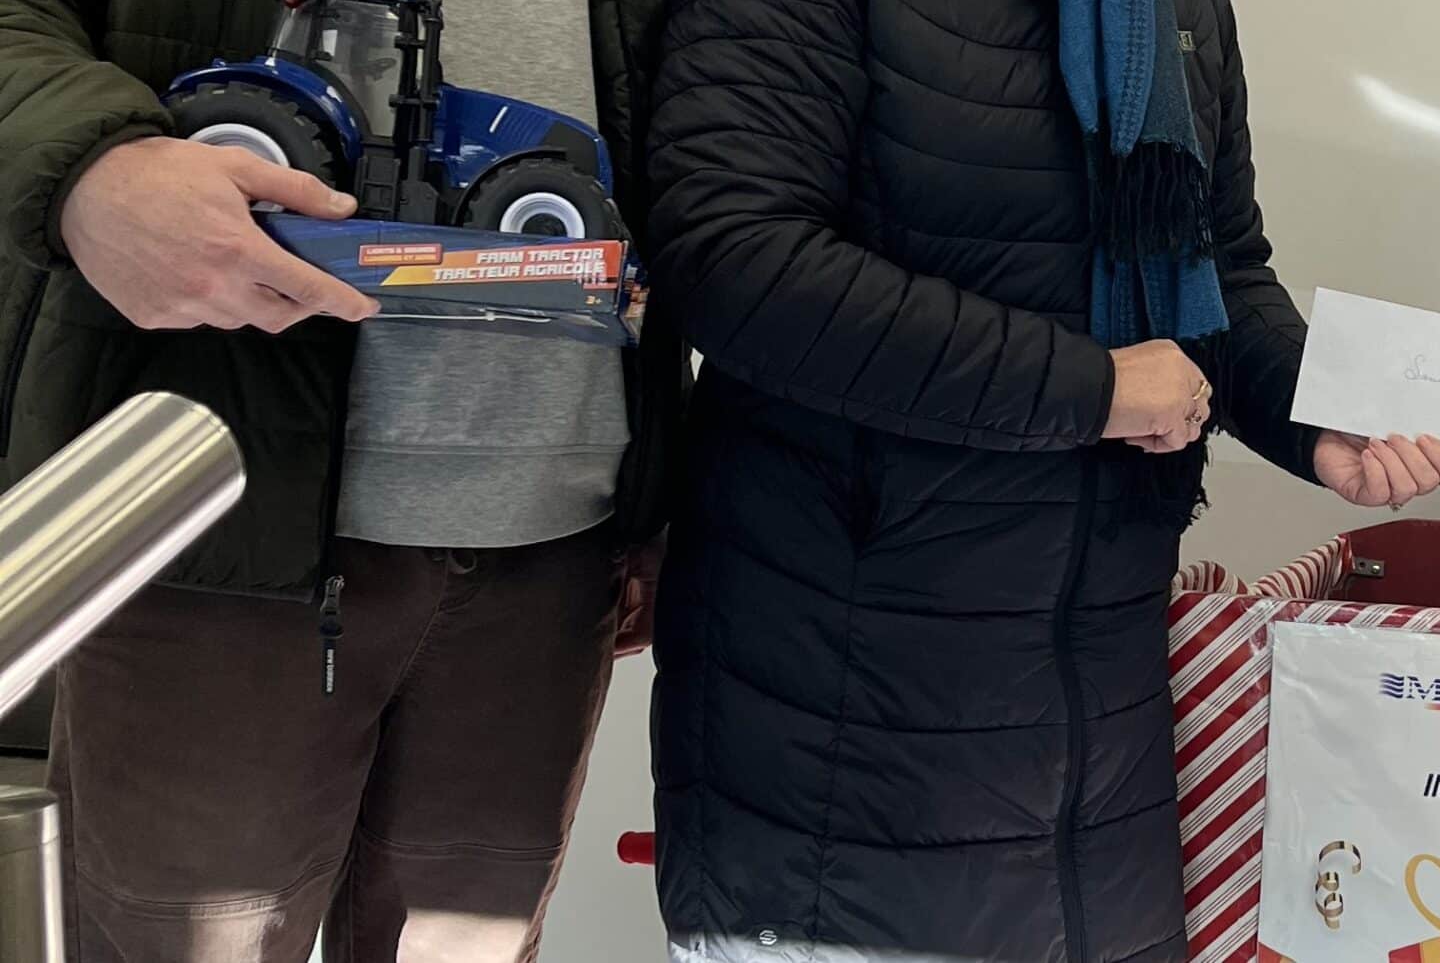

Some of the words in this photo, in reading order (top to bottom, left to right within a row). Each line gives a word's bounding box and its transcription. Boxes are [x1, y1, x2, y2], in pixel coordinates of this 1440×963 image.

[476, 251, 524, 264] FARM
[528, 248, 604, 262] TRACTOR
[432, 265, 519, 281] TRACTEUR
[523, 261, 606, 277] AGRICOLE
